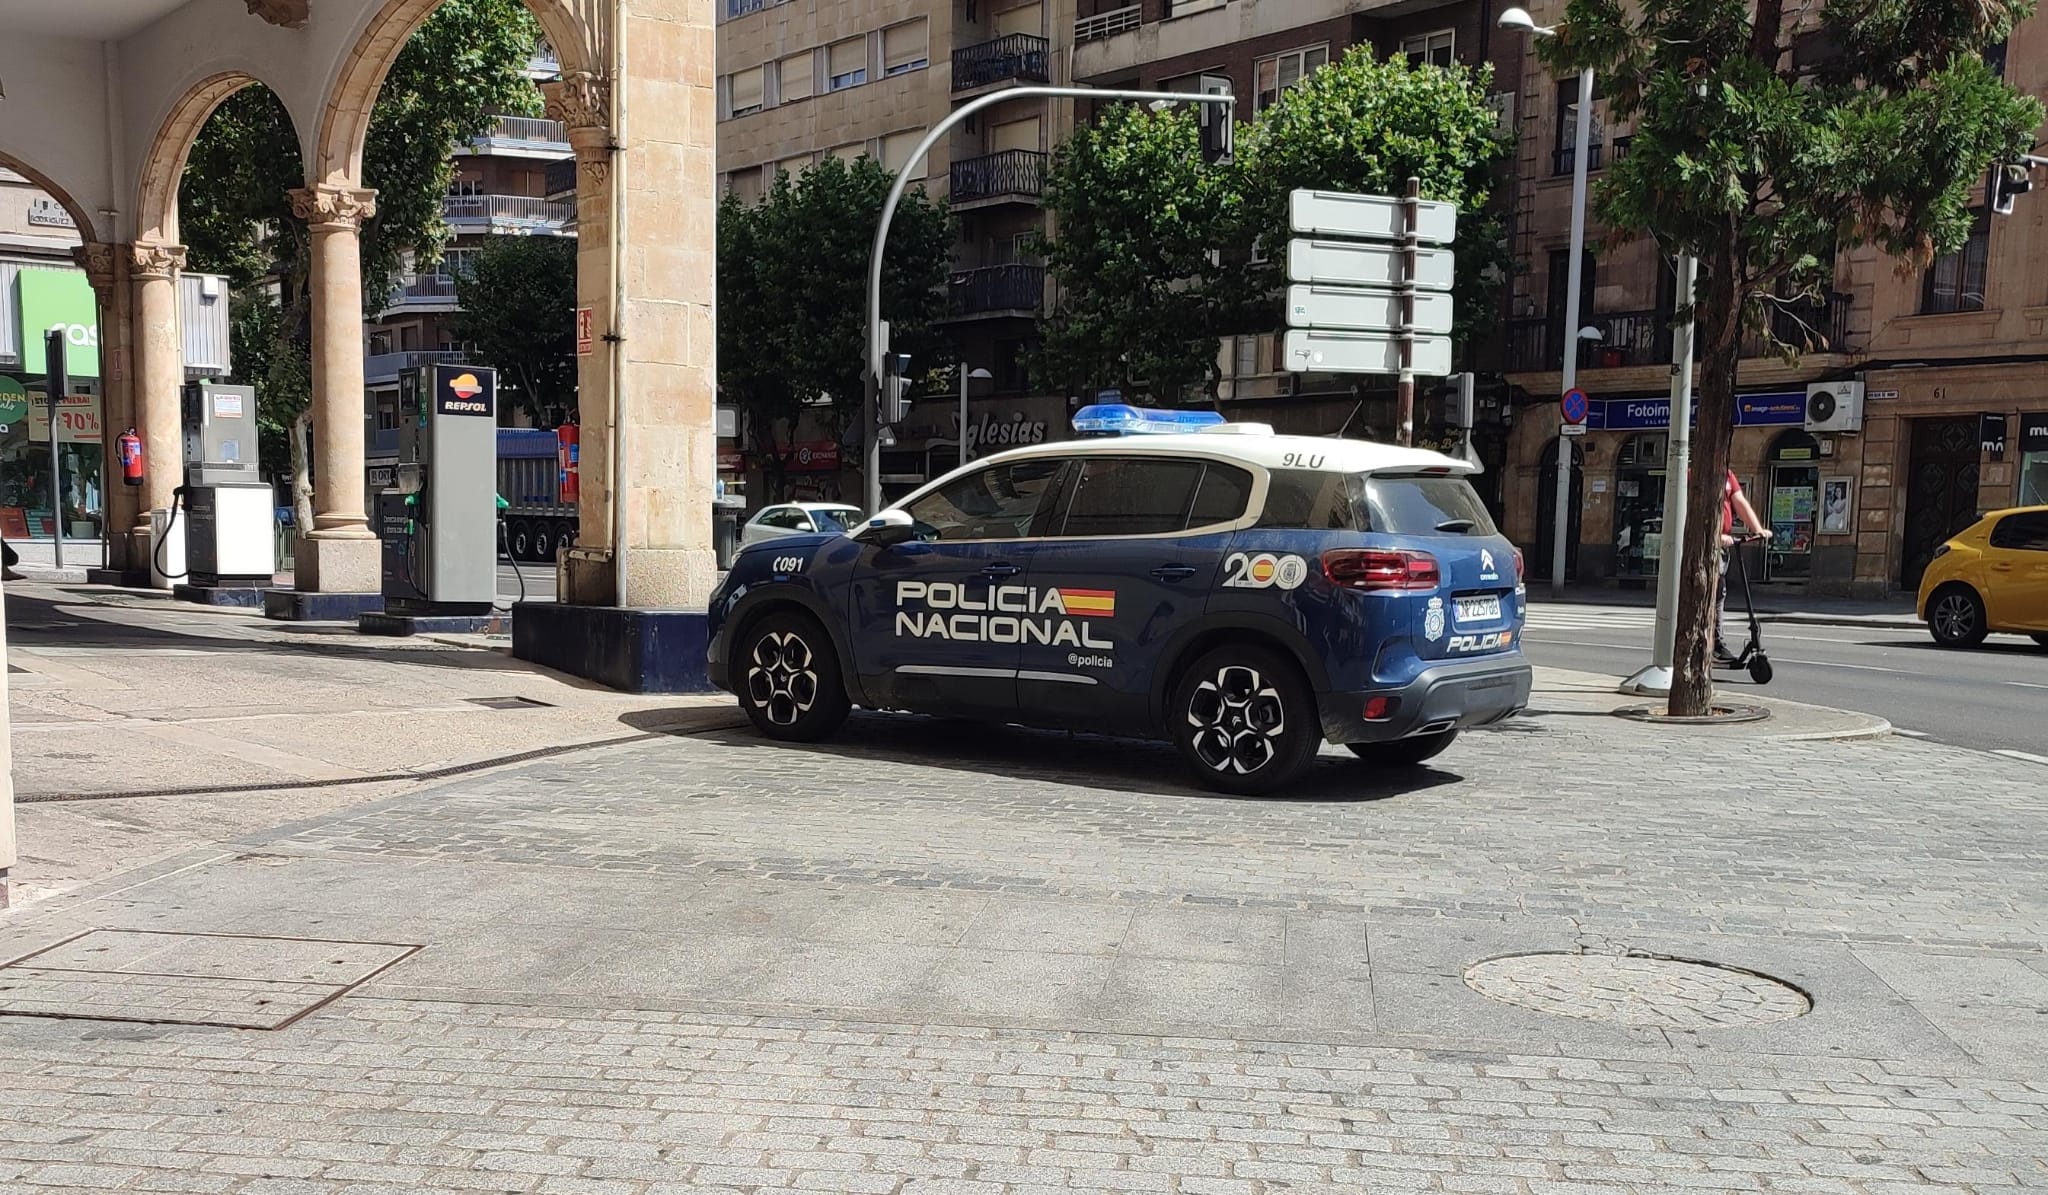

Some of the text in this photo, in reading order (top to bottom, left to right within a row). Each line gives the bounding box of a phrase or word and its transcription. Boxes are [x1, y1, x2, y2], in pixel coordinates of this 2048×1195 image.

[1934, 387, 1946, 399] 61
[444, 401, 487, 412] REPSOL
[61, 412, 100, 430] 70%
[1282, 452, 1326, 469] 9LU
[895, 611, 1114, 650] NACIONAL
[1067, 653, 1113, 668] @policia
